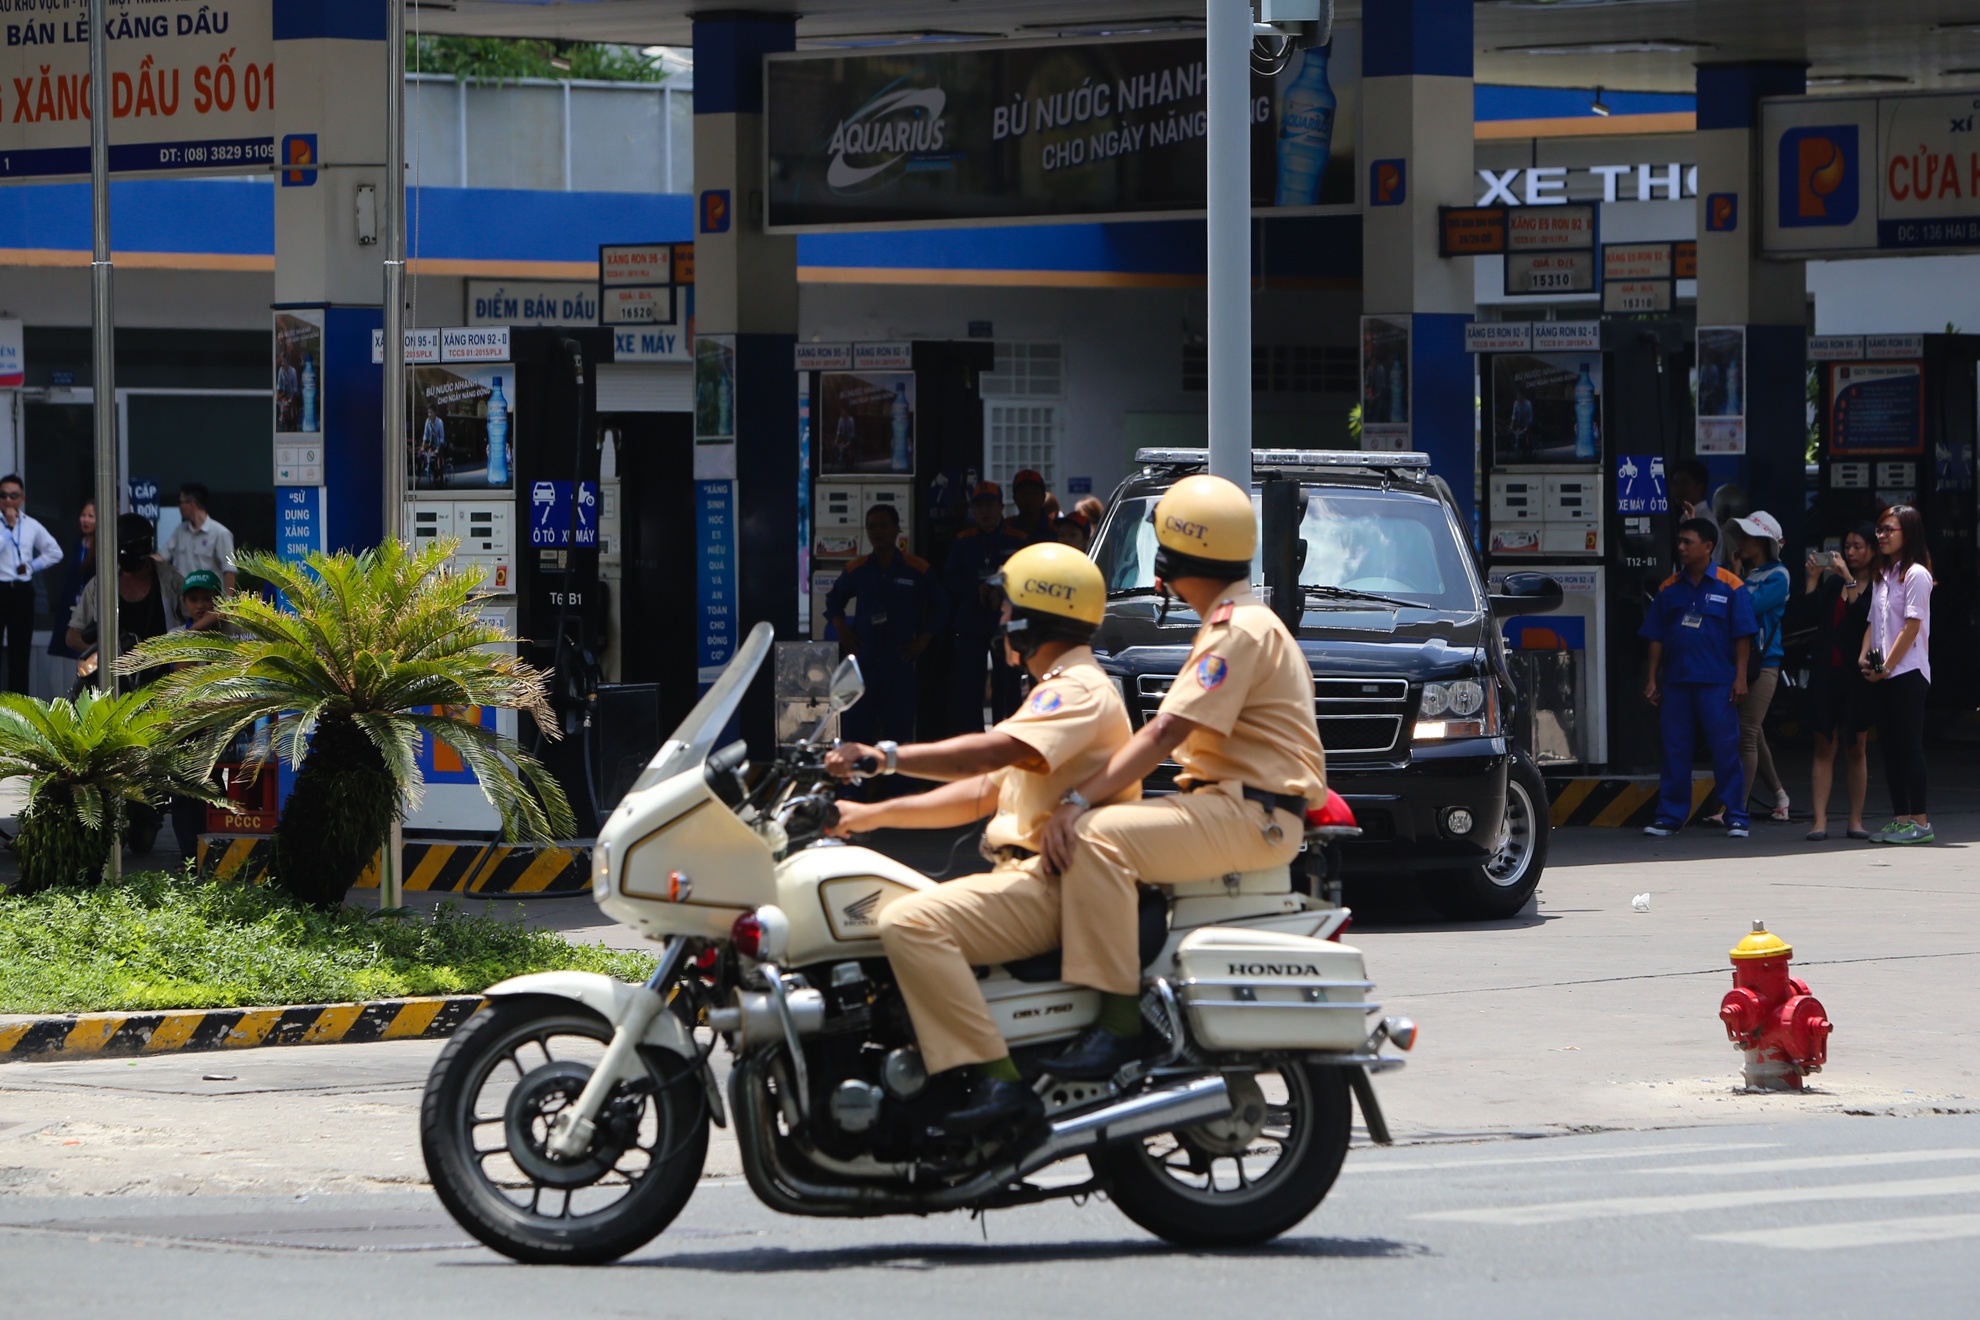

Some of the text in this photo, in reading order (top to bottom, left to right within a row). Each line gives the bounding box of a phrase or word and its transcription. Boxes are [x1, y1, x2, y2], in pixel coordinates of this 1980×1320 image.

[7, 6, 228, 46] BÁN LẺ XĂNG DẦU
[112, 54, 179, 118] DẦU
[194, 47, 236, 114] SỐ
[244, 62, 273, 112] 01
[993, 92, 1028, 140] BÙ
[1036, 76, 1110, 131] NƯỚC
[1950, 115, 1973, 132] XÍ
[828, 119, 946, 154] AQUARIUS
[1042, 138, 1084, 171] CHO
[1090, 121, 1144, 160] NGÀY
[1150, 109, 1207, 147] NĂNG
[184, 147, 208, 162] (08)
[211, 146, 242, 160] 3829
[245, 144, 273, 158] 5109
[1888, 144, 1961, 201] CỬA
[1476, 168, 1569, 207] XE
[1510, 216, 1537, 230] XĂNG
[1551, 217, 1569, 229] RON
[1571, 217, 1583, 229] 92
[1923, 225, 1942, 240] 136
[1945, 223, 1965, 238] HAI
[1533, 273, 1569, 287] 15310
[476, 288, 595, 319] ĐIỂM BÁN DẦU
[622, 307, 652, 318] 16520
[444, 334, 466, 346] XĂNG
[468, 333, 486, 345] RON
[488, 333, 496, 344] 92
[1467, 327, 1485, 338] XĂNG
[1497, 328, 1511, 337] RON
[1513, 327, 1520, 337] 92
[1535, 326, 1557, 337] XĂNG
[1559, 326, 1576, 336] RON
[1578, 326, 1586, 336] 92
[405, 336, 416, 347] ON
[418, 336, 427, 347] 95
[615, 329, 675, 353] XE MÁY
[454, 379, 478, 391] NHANH
[1618, 499, 1628, 511] XE
[1629, 497, 1645, 511] MÁY
[1658, 497, 1668, 511] TÔ
[533, 527, 541, 543] Ô
[542, 527, 555, 543] TÔ
[575, 526, 595, 543] MÁY
[1165, 515, 1209, 540] CSGT
[711, 591, 723, 600] AN
[1024, 578, 1077, 600] CSGT
[709, 621, 726, 630] CHO
[225, 814, 262, 829] PCCC
[1228, 964, 1322, 976] HONDA
